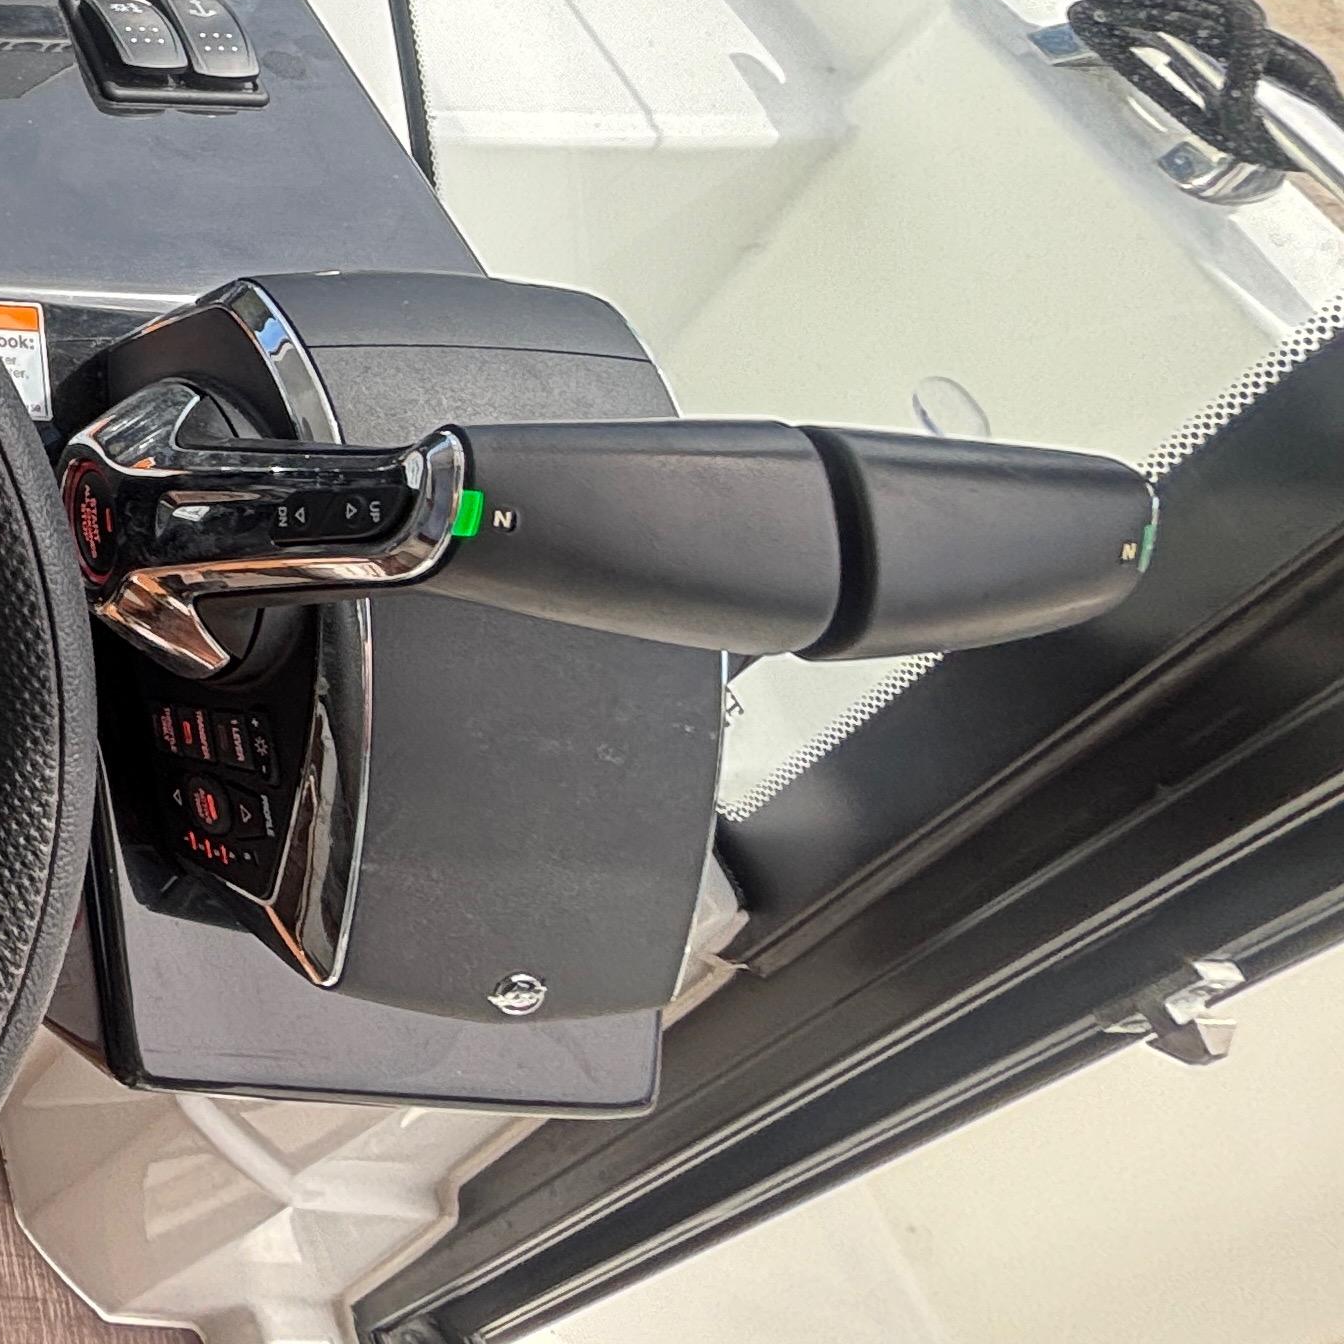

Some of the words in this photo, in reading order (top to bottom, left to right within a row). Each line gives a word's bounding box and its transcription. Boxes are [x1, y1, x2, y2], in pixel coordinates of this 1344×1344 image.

[368, 499, 381, 524] UP
[493, 510, 511, 528] N
[1120, 541, 1138, 561] N
[232, 727, 245, 761] LEVER
[260, 794, 276, 838] PROFILE
